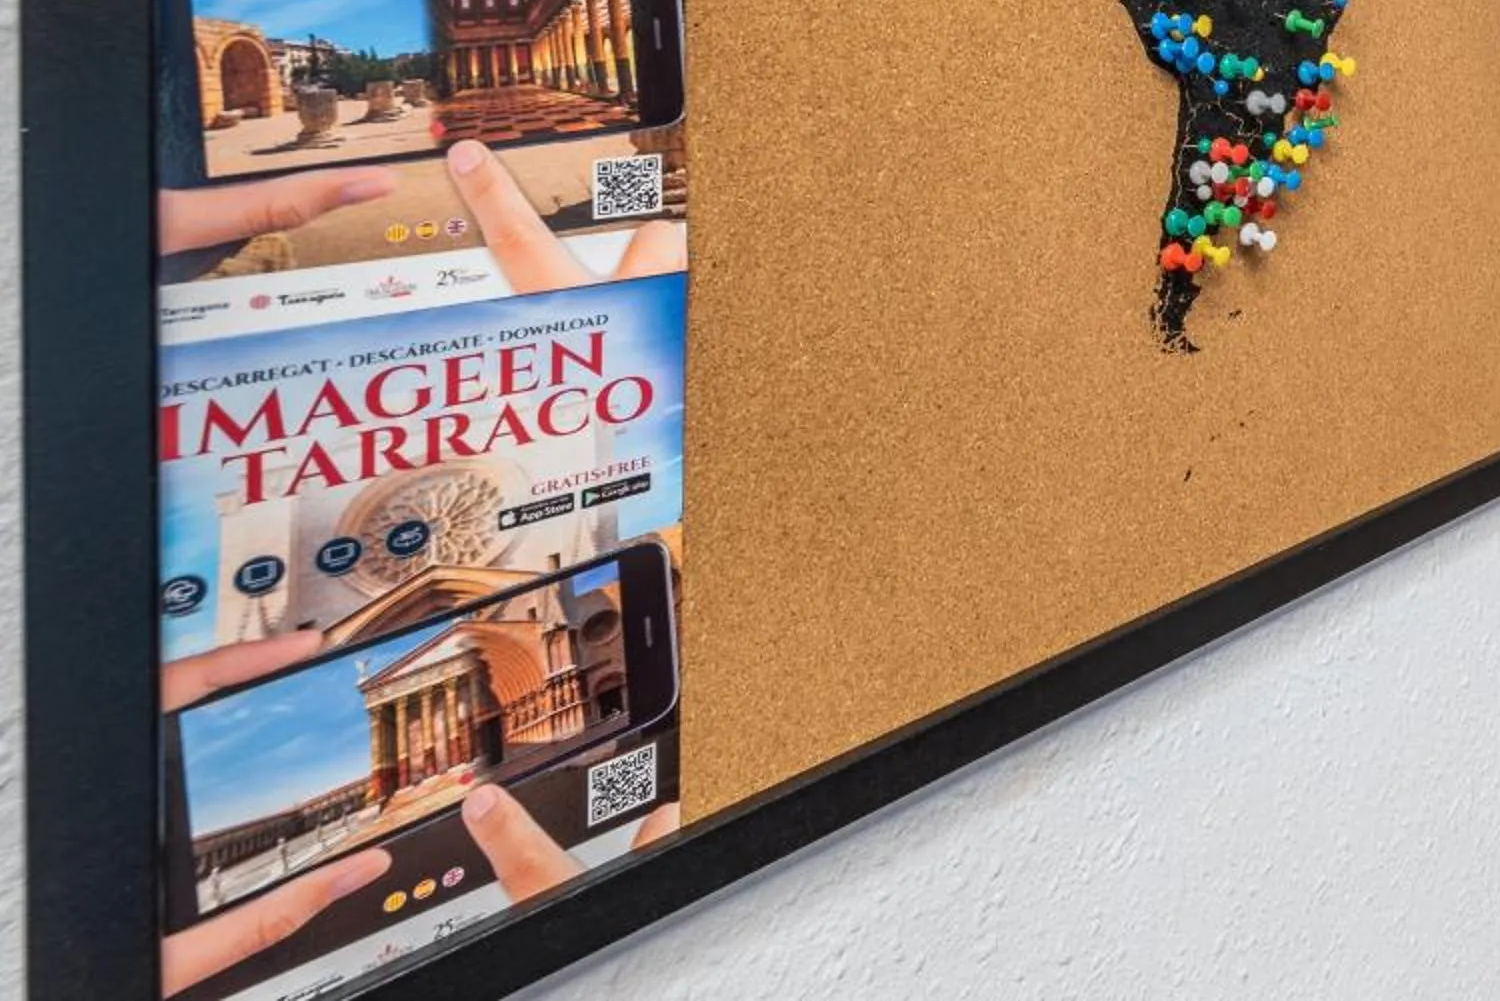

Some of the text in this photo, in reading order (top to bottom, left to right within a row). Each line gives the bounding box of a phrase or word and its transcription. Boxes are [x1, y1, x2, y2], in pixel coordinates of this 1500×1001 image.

[349, 334, 484, 368] DESCÁRGATE
[500, 314, 610, 341] DOWNLOAD
[159, 331, 607, 463] IMAGEEN
[221, 376, 654, 505] TARRACO
[519, 508, 544, 525] App
[544, 501, 573, 517] Store
